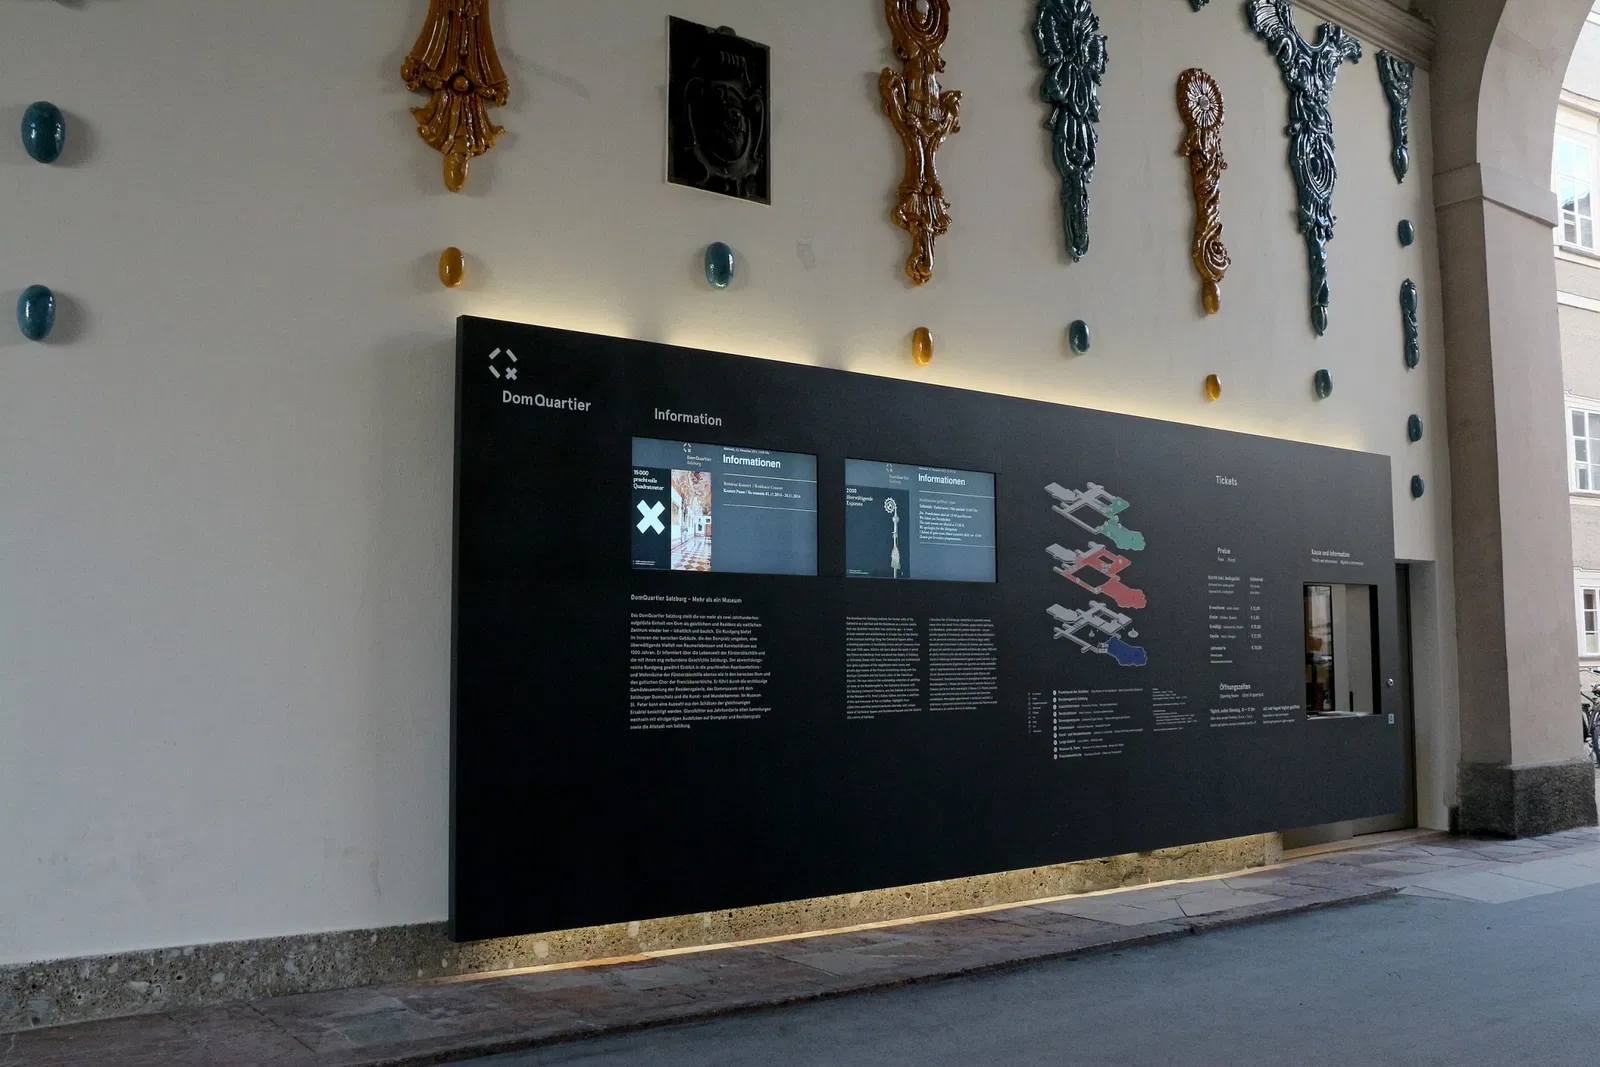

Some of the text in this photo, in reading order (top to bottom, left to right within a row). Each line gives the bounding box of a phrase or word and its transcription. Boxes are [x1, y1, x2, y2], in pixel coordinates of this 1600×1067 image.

[502, 389, 592, 412] DomQuartier
[654, 407, 722, 427] Information
[723, 454, 781, 469] Informationen
[918, 473, 966, 486] Informationen
[1215, 475, 1238, 486] Tickets
